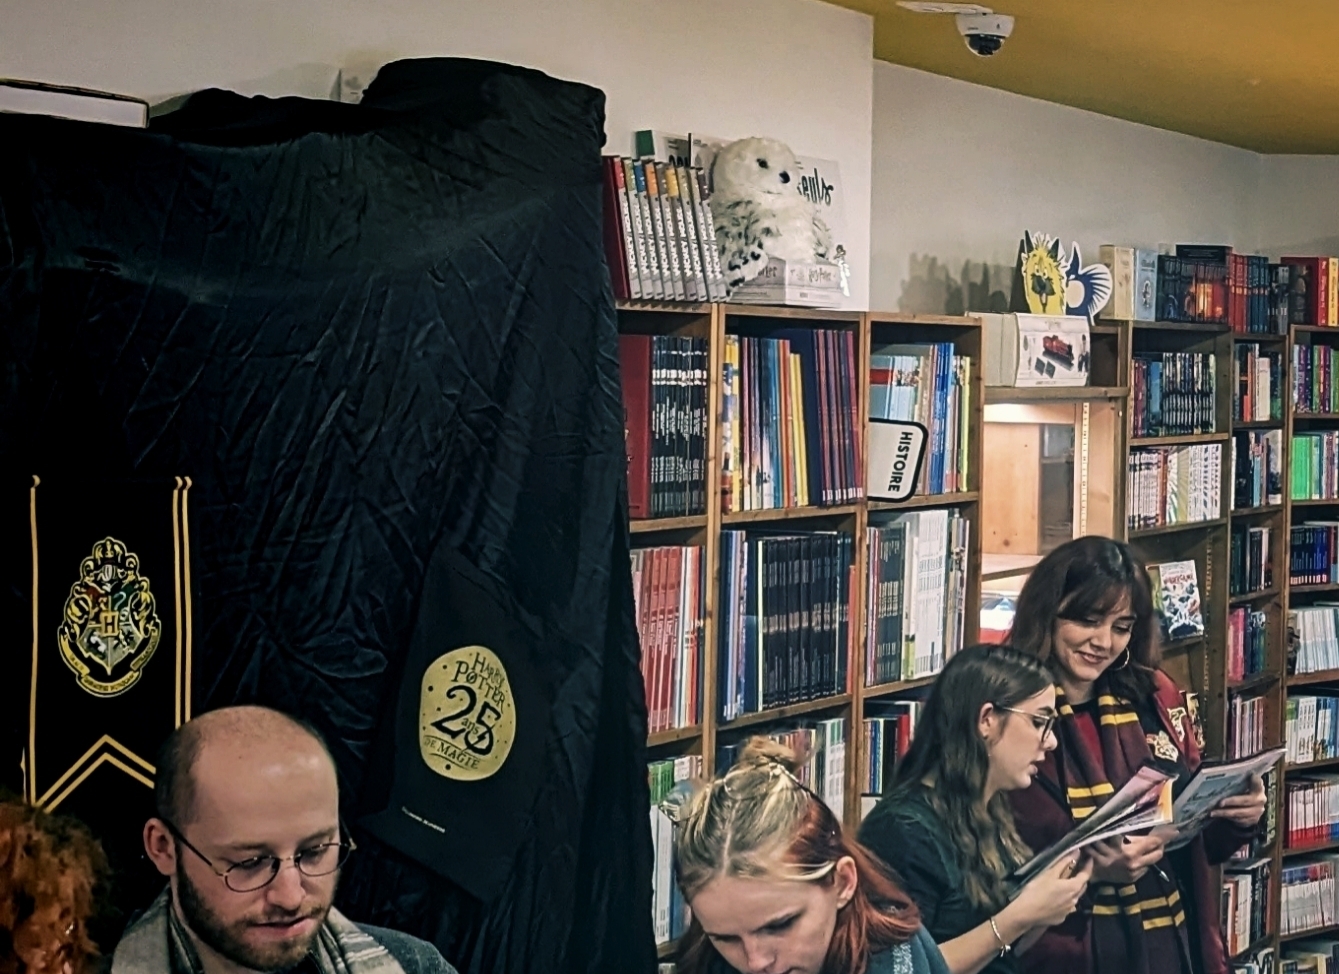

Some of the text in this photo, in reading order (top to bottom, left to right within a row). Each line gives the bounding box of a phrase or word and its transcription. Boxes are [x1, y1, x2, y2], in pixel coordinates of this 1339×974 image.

[887, 431, 913, 492] HISTOIRE
[430, 685, 502, 756] 25
[436, 743, 481, 770] MAGIE
